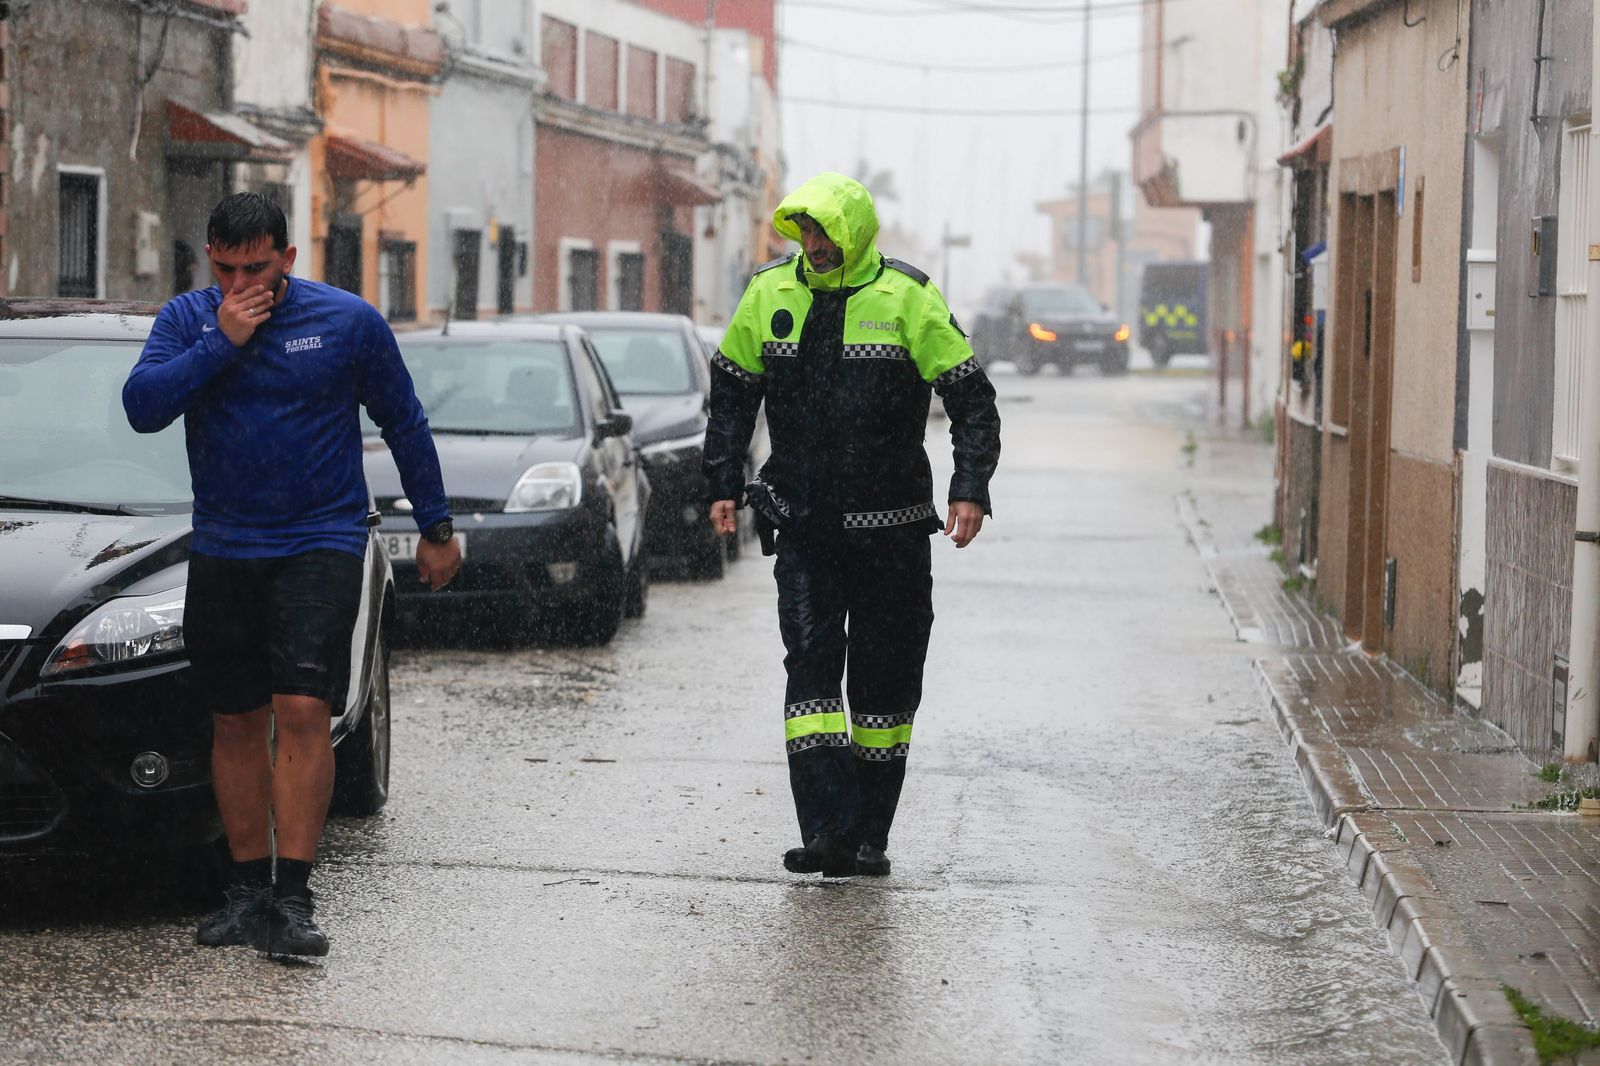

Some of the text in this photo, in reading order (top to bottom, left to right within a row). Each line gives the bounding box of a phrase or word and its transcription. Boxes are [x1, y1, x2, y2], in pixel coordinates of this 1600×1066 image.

[859, 320, 900, 331] POLICIA
[285, 336, 320, 348] SAINTS
[286, 343, 322, 353] FOOTBALL
[381, 536, 411, 555] 81
